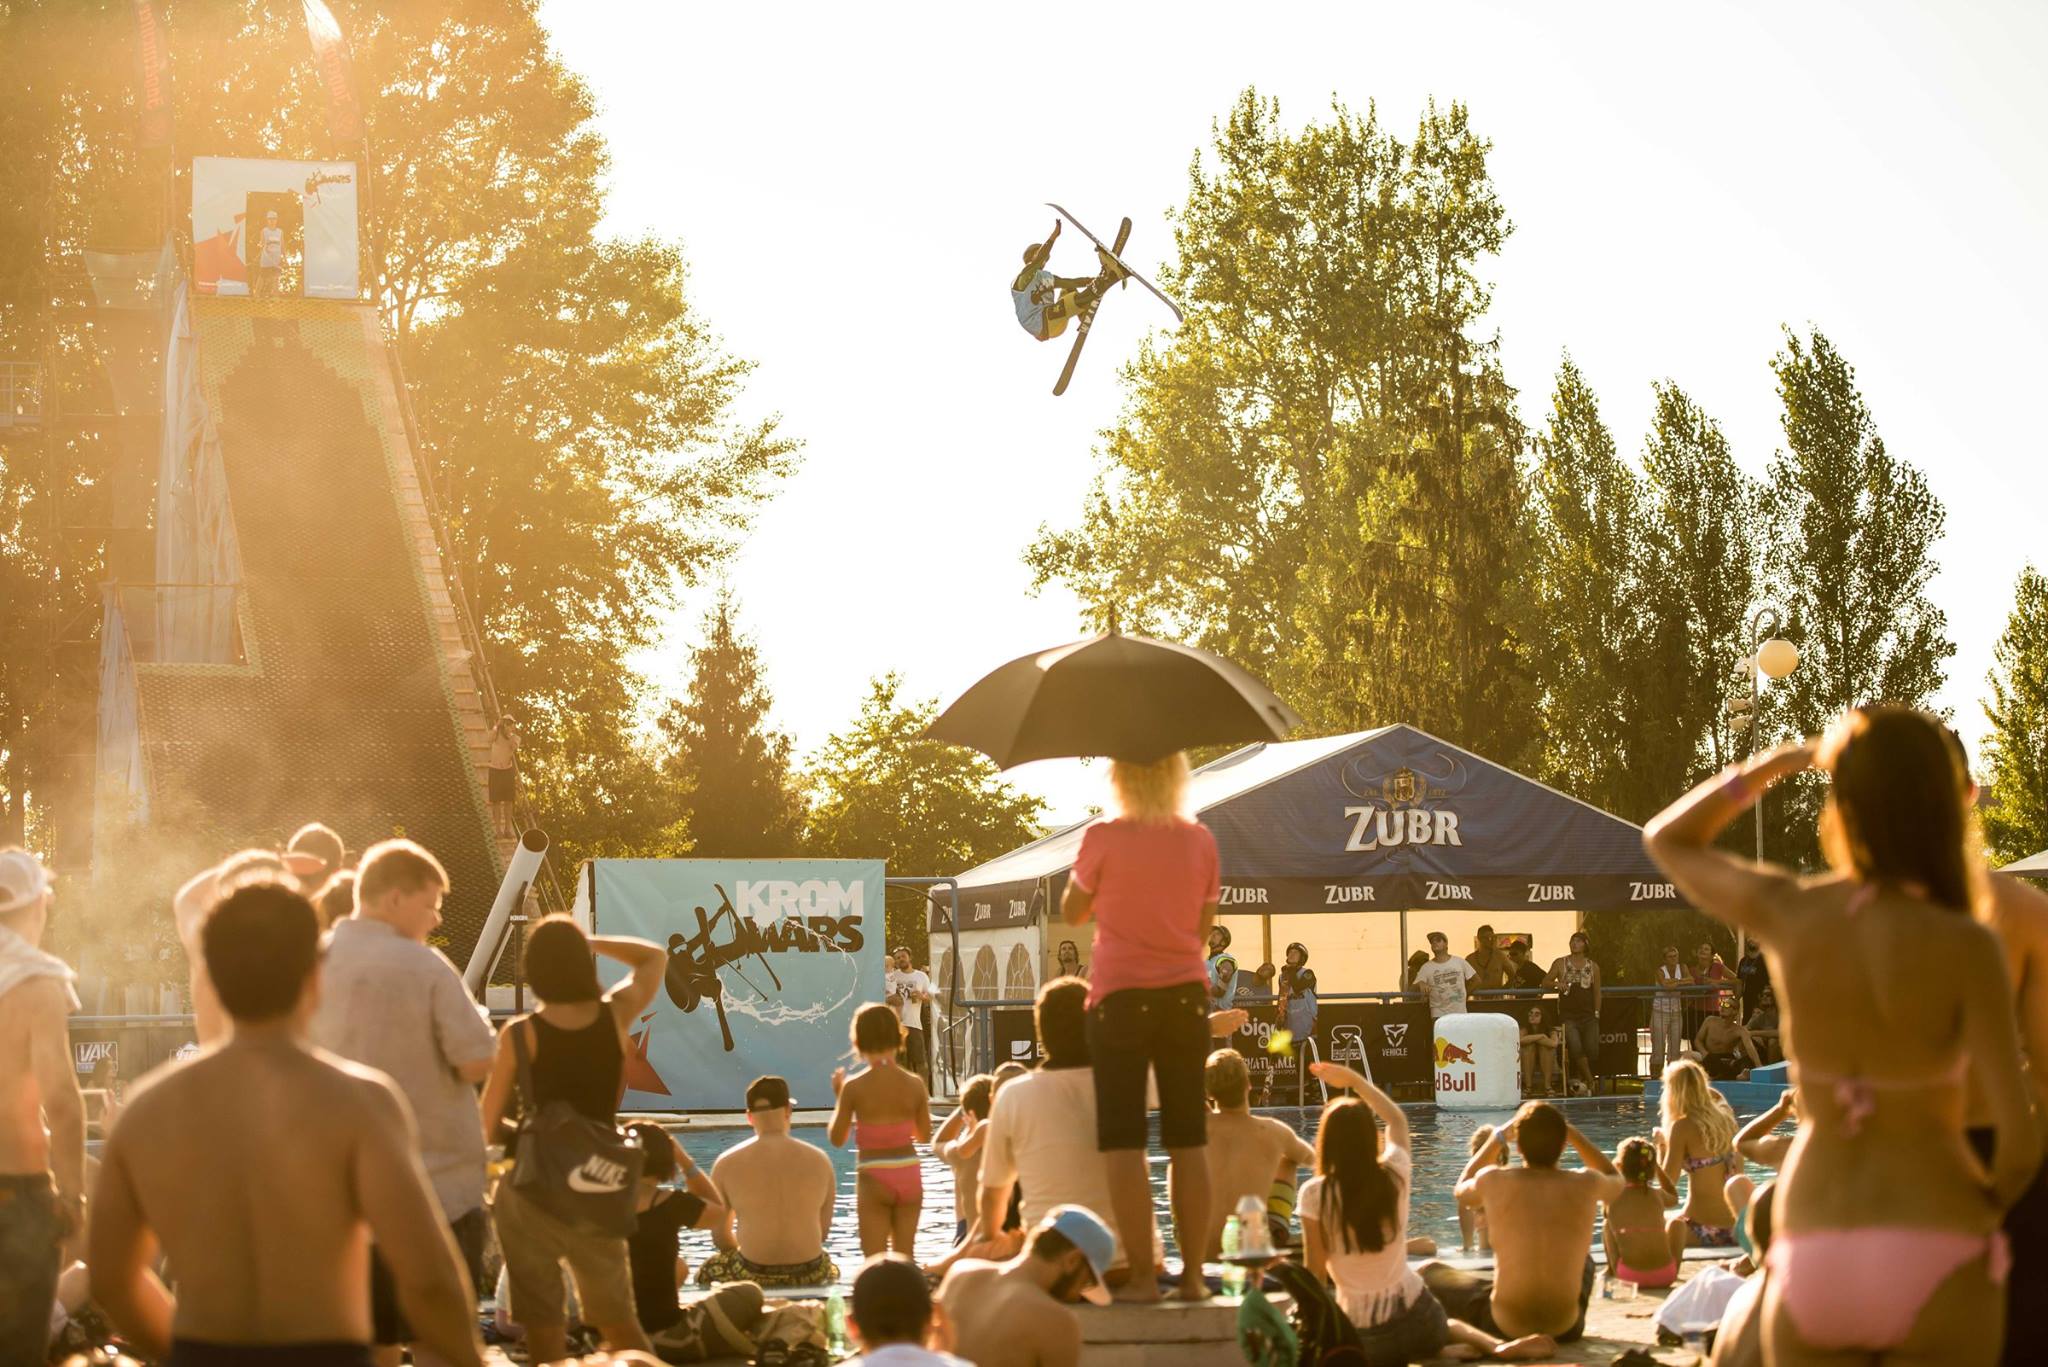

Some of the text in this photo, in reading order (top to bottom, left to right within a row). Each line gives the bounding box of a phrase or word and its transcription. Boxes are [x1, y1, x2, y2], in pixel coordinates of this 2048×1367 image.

[1344, 805, 1463, 852] ZUBR
[736, 880, 864, 917] KROM
[1219, 885, 1269, 905] ZUBR
[1324, 885, 1375, 904] ZUBR
[1425, 881, 1473, 900] ZUBR
[1527, 883, 1576, 902] ZUBR
[1629, 882, 1676, 900] ZUBR
[974, 903, 991, 922] ZUBR
[1009, 900, 1026, 919] ZUBR
[743, 915, 864, 952] WARS
[80, 1044, 112, 1062] VAK
[583, 1154, 628, 1187] NIKE
